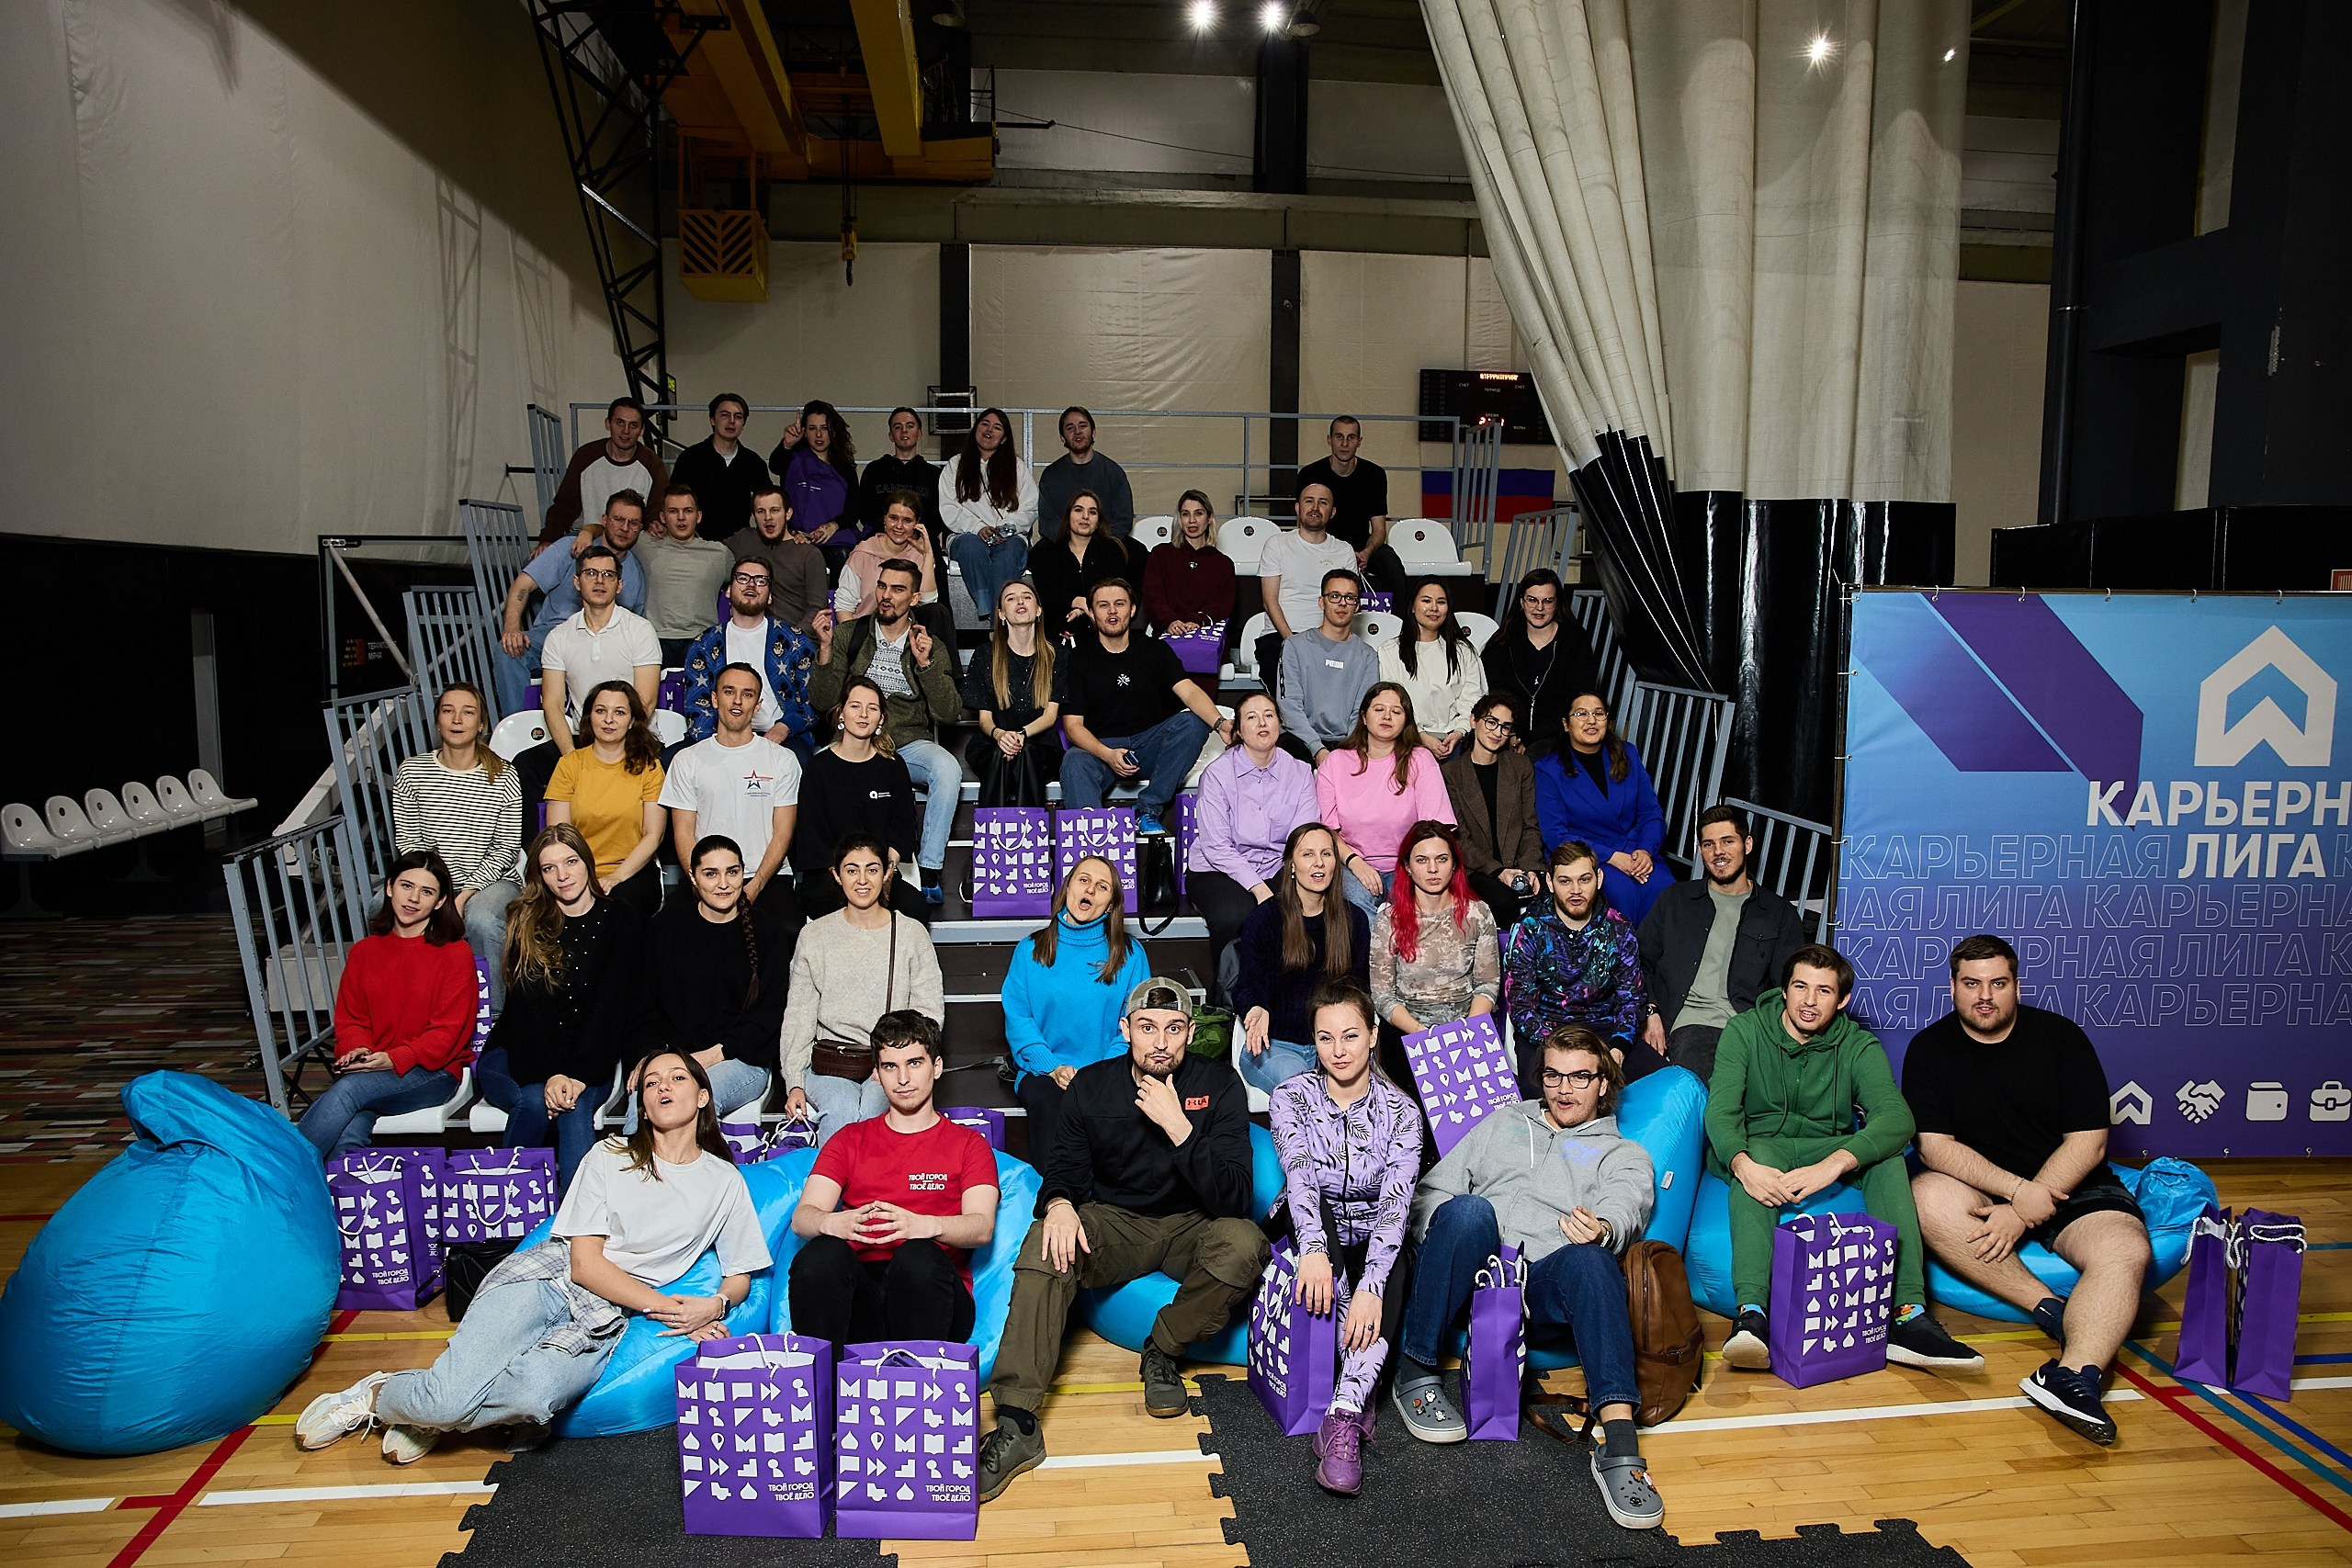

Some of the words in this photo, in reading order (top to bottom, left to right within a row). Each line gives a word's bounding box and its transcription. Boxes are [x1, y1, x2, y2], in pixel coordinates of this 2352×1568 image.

[1325, 659, 1344, 669] PUMA
[2086, 781, 2352, 826] КАРЬЕРН
[1839, 835, 2170, 879] КАРЬЕРНАЯ
[2177, 833, 2326, 879] ЛИГА
[1929, 885, 2072, 930] ЛИГА
[1838, 935, 2165, 980] КАРРНАЯ
[2169, 933, 2312, 977] ЛИГА
[1849, 987, 1918, 1030] АЯ
[909, 1172, 925, 1181] ТВОЙ
[926, 1173, 948, 1182] ГОРОД
[910, 1181, 927, 1190] ТВОЁ
[768, 1483, 787, 1492] ТВОЙ
[788, 1482, 814, 1492] ГОРОД
[925, 1483, 944, 1493] ТВОЙ
[945, 1484, 970, 1494] ГОРОД
[775, 1492, 794, 1501] ТВОЁ
[795, 1492, 815, 1501] ДЕЛО
[932, 1494, 951, 1502] ТВОЁ
